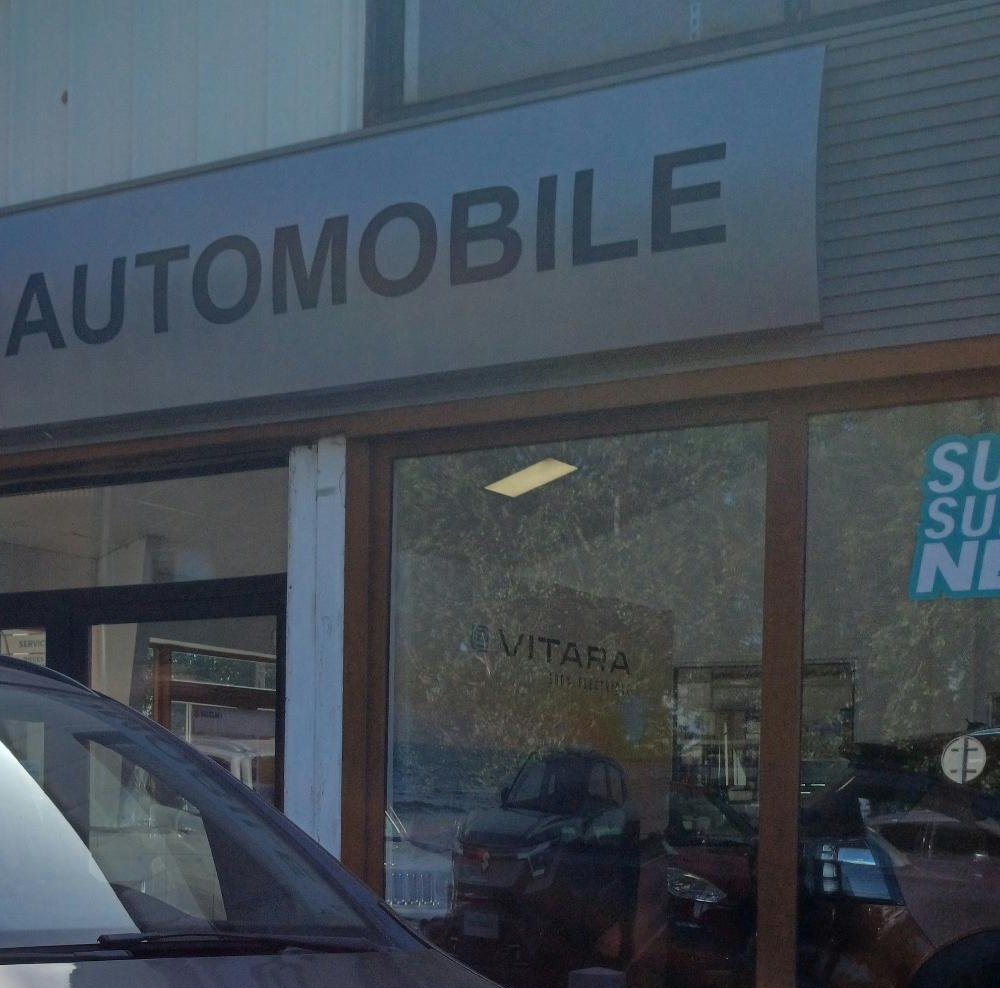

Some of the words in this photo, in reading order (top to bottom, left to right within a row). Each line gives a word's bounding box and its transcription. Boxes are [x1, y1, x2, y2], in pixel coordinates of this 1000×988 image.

[4, 142, 727, 357] AUTOMOBILE
[924, 494, 1000, 540] SU
[499, 628, 630, 676] VITARA
